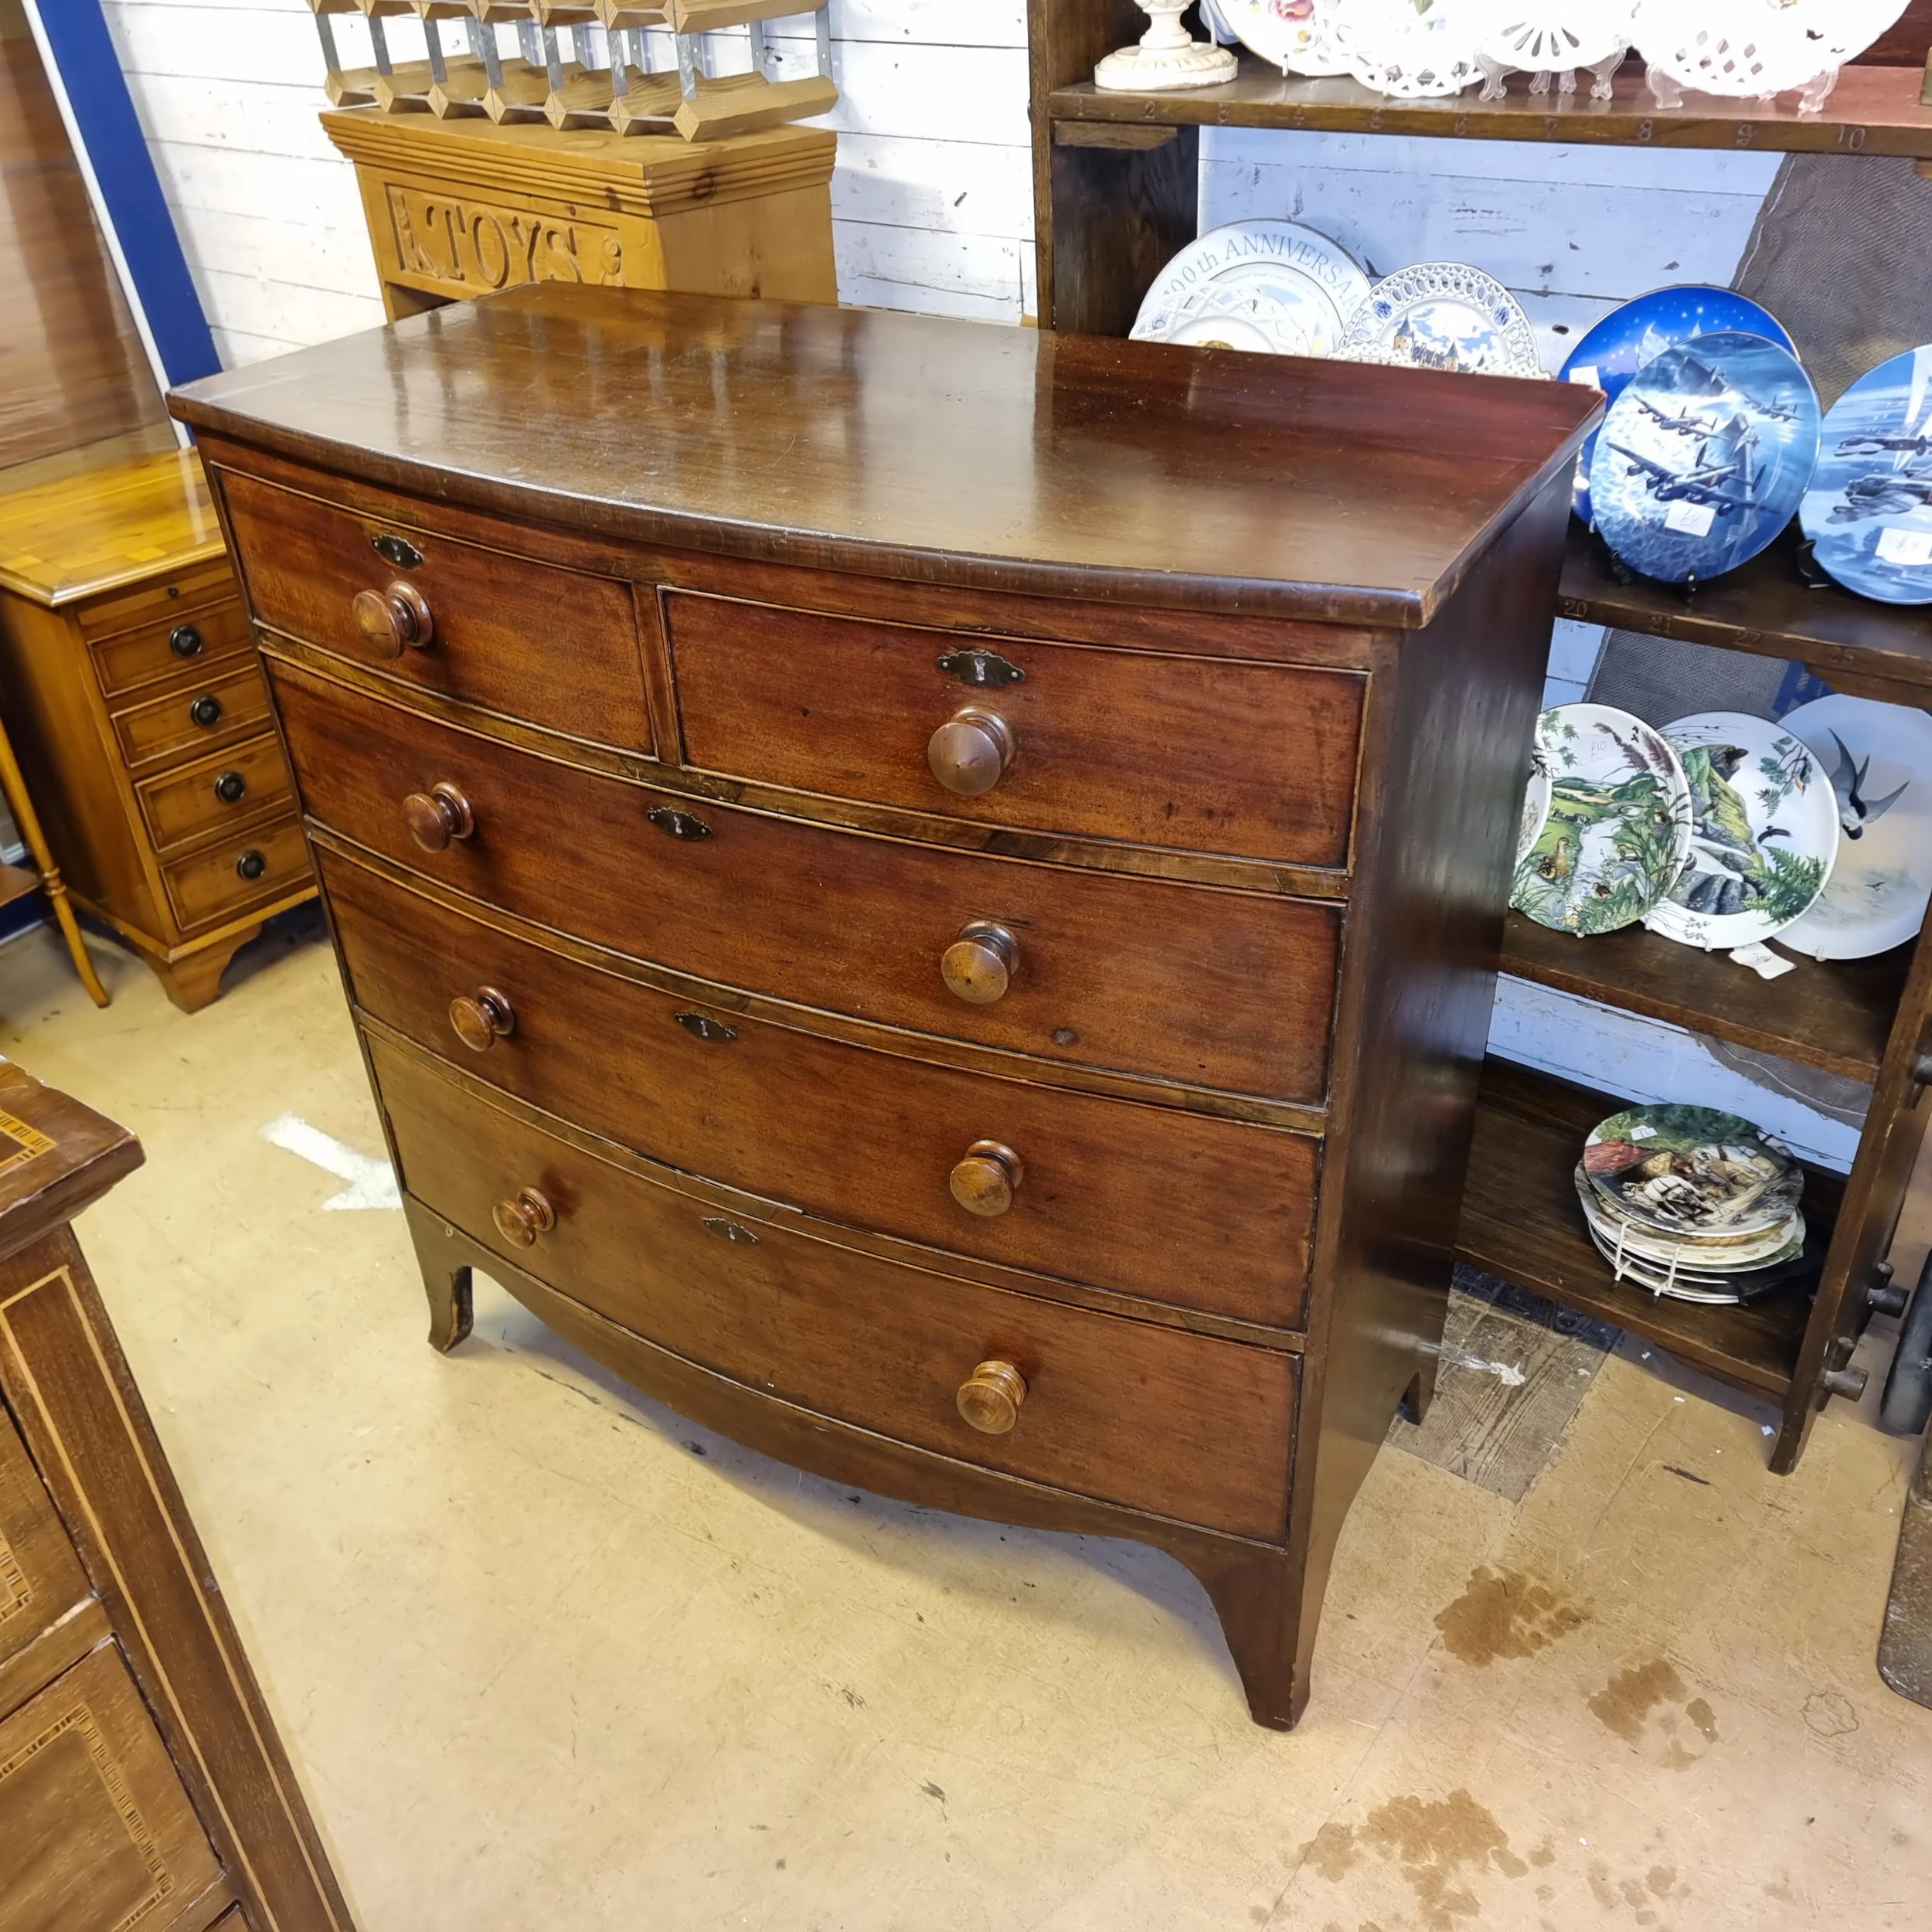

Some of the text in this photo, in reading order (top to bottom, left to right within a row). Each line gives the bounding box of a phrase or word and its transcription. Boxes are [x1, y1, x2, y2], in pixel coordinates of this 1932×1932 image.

[1142, 100, 1156, 119] 2
[1638, 119, 1653, 141] 8
[1838, 124, 1866, 150] 10
[424, 202, 584, 288] TOYS
[1162, 251, 1219, 295] 00th
[1563, 599, 1588, 617] 20
[1590, 740, 1607, 757] £10
